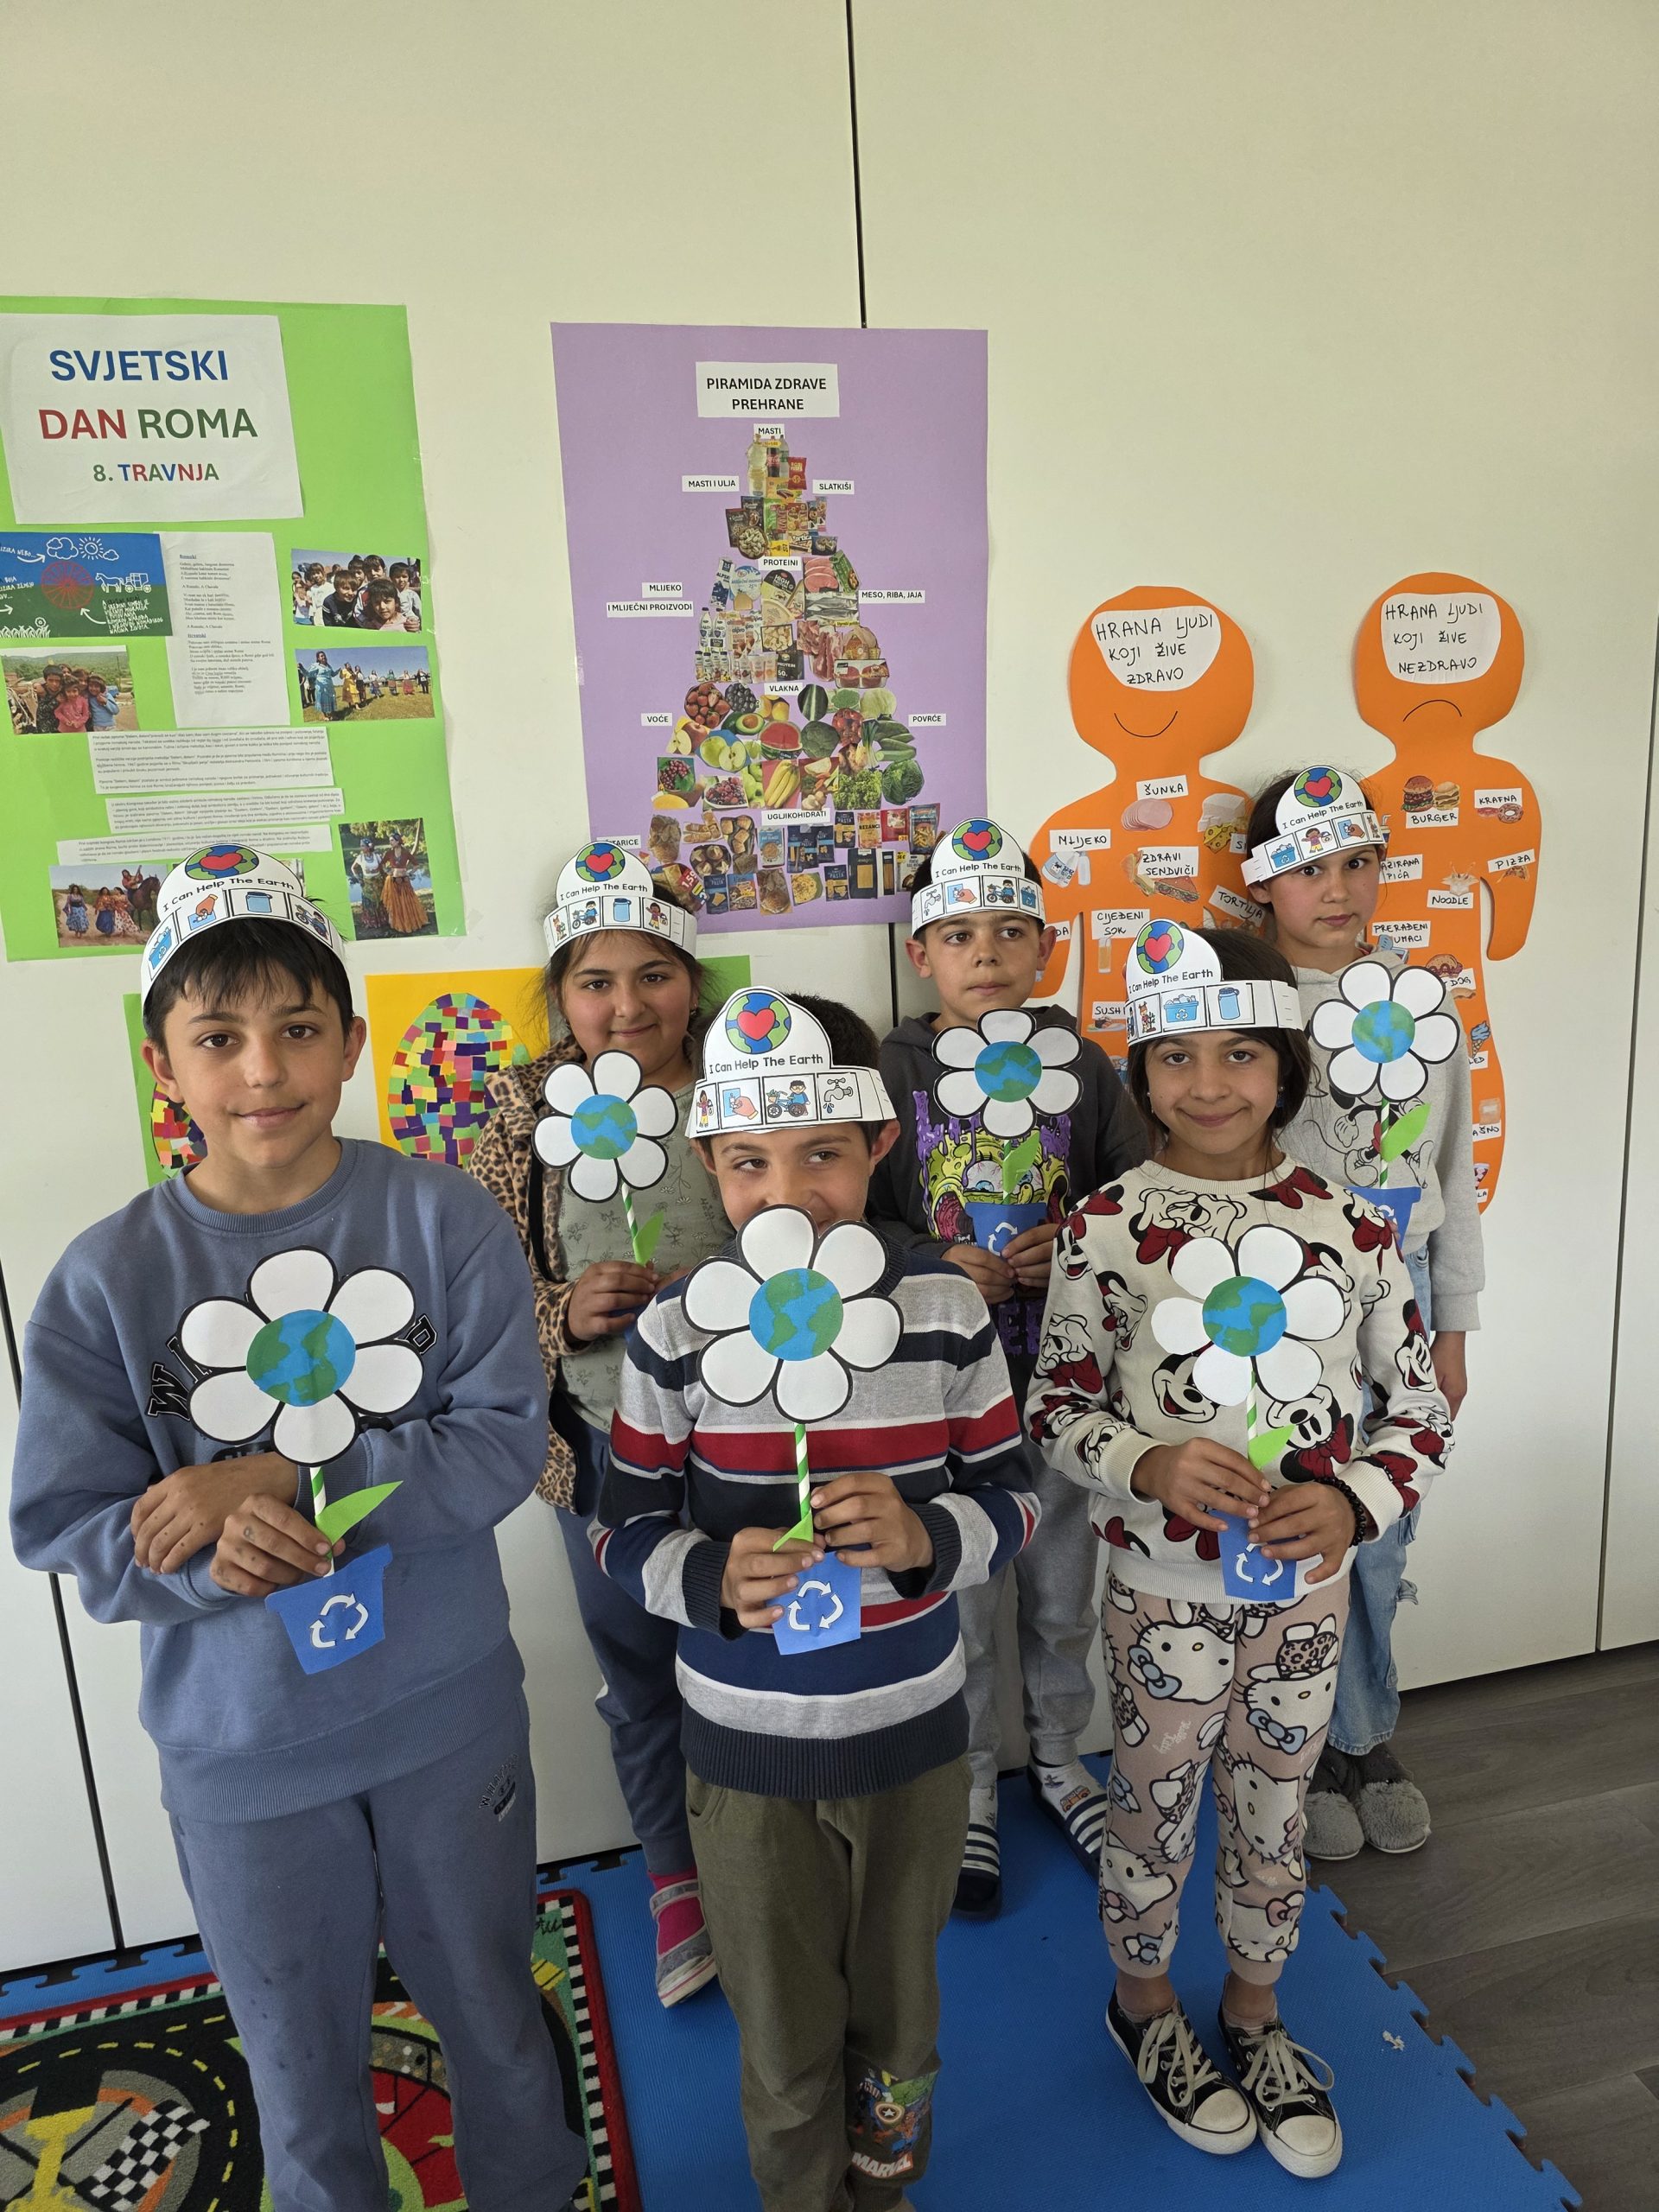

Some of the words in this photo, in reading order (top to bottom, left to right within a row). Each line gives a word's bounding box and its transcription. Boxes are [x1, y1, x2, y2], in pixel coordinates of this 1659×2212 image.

[49, 349, 228, 381] SVJETSKI
[707, 378, 772, 390] PIRAMIDA
[775, 378, 827, 390] ZDRAVE
[732, 398, 804, 410] PREHRANE
[38, 409, 127, 439] DAN
[137, 409, 258, 439] ROMA
[92, 464, 113, 481] 8.
[118, 463, 219, 481] TRAVNJA
[612, 602, 648, 611] MLIJEČNI
[1385, 603, 1437, 620] HRANA
[1447, 602, 1483, 624] LJUDI
[1096, 617, 1161, 641] HRANA
[1176, 613, 1212, 639] LJUDI
[1393, 632, 1423, 651] KOJI
[1439, 630, 1467, 644] ŽIVE
[1109, 645, 1141, 666] KOJI
[1154, 641, 1186, 657] ŽIVE
[1398, 657, 1477, 674] NEZDRAVO
[1127, 667, 1184, 684] ZDRAVO
[1144, 783, 1184, 796] ŠUNKA
[1479, 794, 1516, 804] KRAFNA
[767, 810, 826, 820] UGLJIKOHIDRATI
[1290, 817, 1306, 826] Can
[1307, 810, 1327, 820] Help
[1329, 804, 1344, 813] The
[1344, 800, 1363, 809] Earth
[1410, 812, 1457, 824] BURGER
[1058, 835, 1107, 849] MLIJEKO
[1142, 852, 1181, 862] ZDRAVI
[1381, 857, 1420, 870] AZIRANA
[1495, 854, 1530, 868] PIZZA
[959, 864, 980, 873] Help
[1001, 863, 1021, 873] Earth
[1145, 865, 1194, 876] SENDVIČI
[1386, 868, 1409, 880] PIĆA
[162, 903, 168, 912] I
[171, 891, 194, 905] Can
[196, 880, 225, 893] Help
[257, 879, 295, 890] Earth
[565, 890, 580, 899] Can
[582, 886, 601, 894] Help
[622, 884, 648, 893] Earth
[1217, 891, 1263, 919] TORTILJA
[1432, 895, 1469, 905] NOODLE
[1104, 926, 1126, 935] SOK
[1394, 935, 1422, 944] UMACI
[1132, 983, 1142, 993] Can
[1142, 978, 1160, 988] Help
[1162, 974, 1179, 984] The
[1182, 969, 1213, 980] Earth
[1451, 976, 1471, 987] DOG
[1094, 1007, 1126, 1015] SUSHI
[709, 1065, 714, 1074] I
[715, 1063, 732, 1072] Can
[734, 1058, 759, 1071] Help
[763, 1056, 785, 1066] The
[790, 1053, 823, 1065] Earth
[852, 2152, 912, 2177] MARVEL
